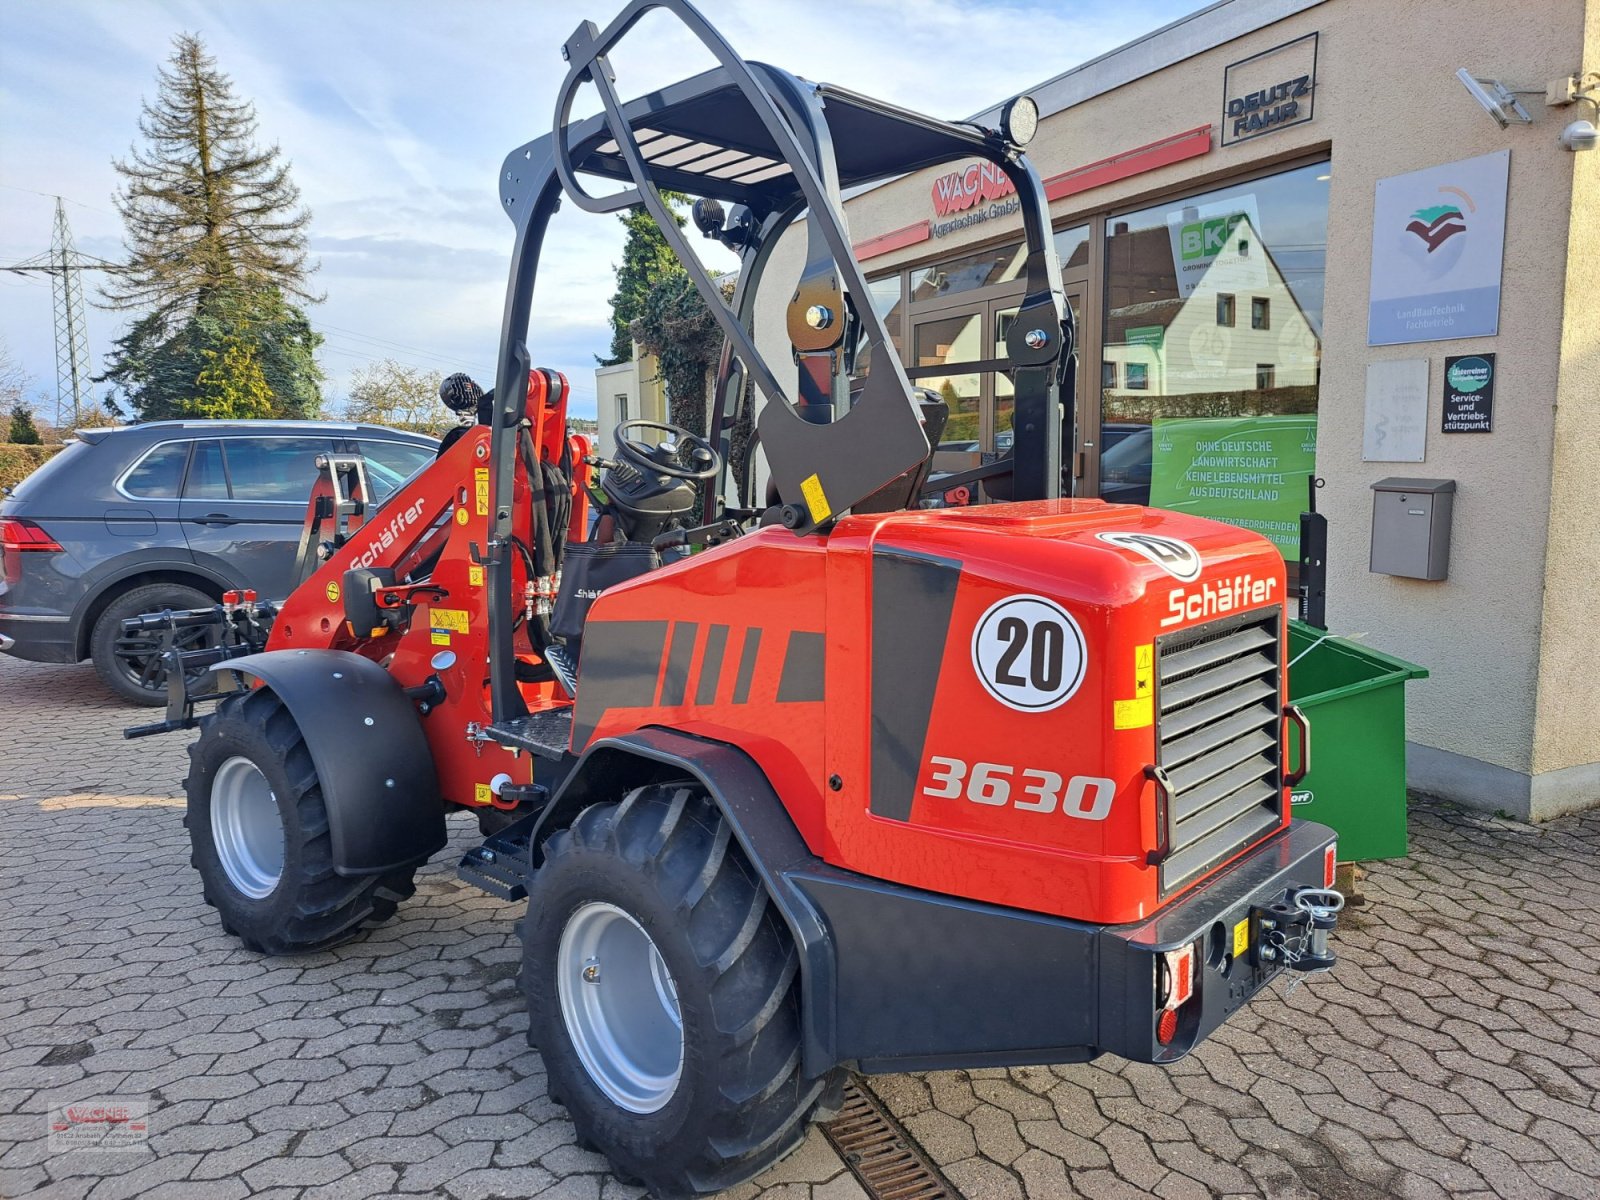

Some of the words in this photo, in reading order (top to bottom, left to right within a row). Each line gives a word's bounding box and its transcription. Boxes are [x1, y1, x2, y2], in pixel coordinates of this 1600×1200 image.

[1228, 75, 1310, 118] DEUTZ
[1233, 101, 1299, 137] FAHR
[931, 163, 1012, 215] WAGNE
[932, 210, 987, 238] Agrartechnik
[988, 198, 1020, 219] GmbH
[1397, 303, 1465, 319] LandBauTechnik
[1406, 317, 1454, 329] Fachbetrieb
[1451, 393, 1483, 402] Service-
[1458, 402, 1475, 411] und
[1447, 411, 1487, 421] Vertriebs-
[1444, 421, 1490, 431] stützpunkt
[1196, 441, 1220, 452] OHNE
[1222, 441, 1272, 452] DEUTSCHE
[1192, 457, 1278, 468] LANDWIRTSCHAFT
[1186, 471, 1212, 482] KEINE
[1213, 472, 1285, 485] LEBENSMITTEL
[1189, 487, 1208, 497] AUS
[1209, 488, 1279, 501] DEUTSCHLAND
[350, 498, 425, 571] Schäffer
[1113, 535, 1192, 563] 20
[1160, 575, 1277, 627] Schäffer
[995, 616, 1064, 692] 20
[923, 755, 1116, 821] 3630
[1291, 792, 1310, 802] orf
